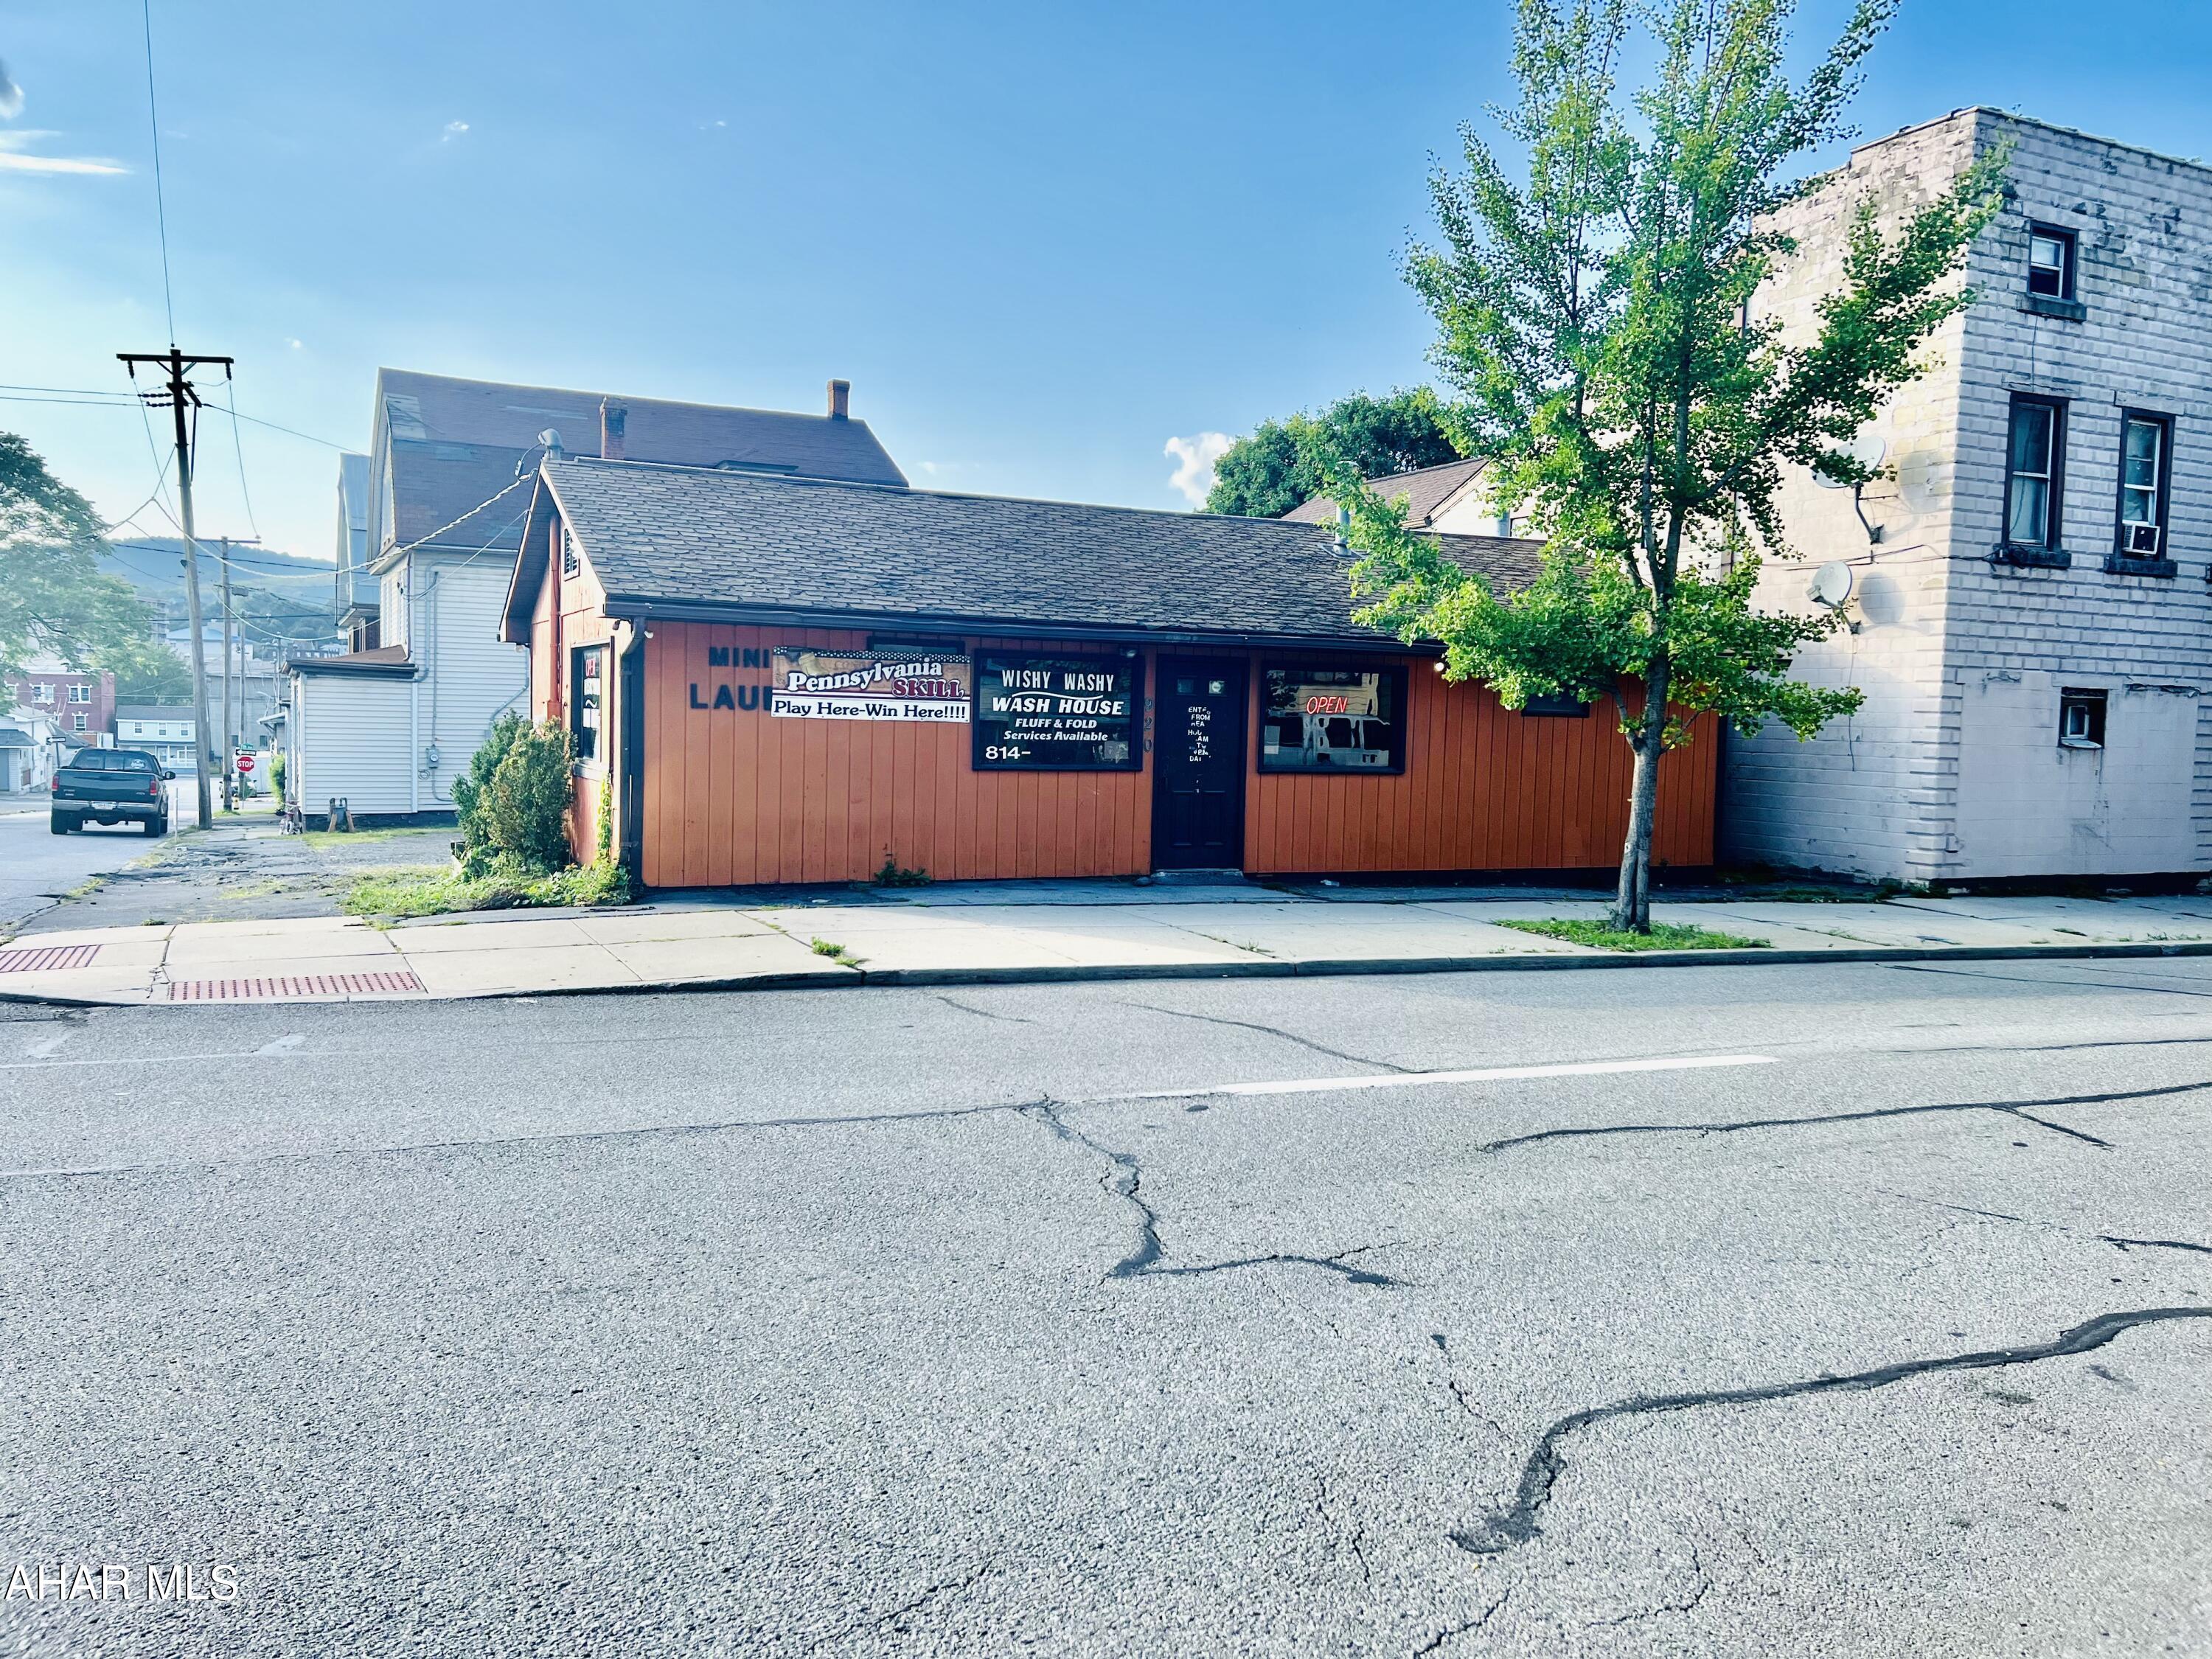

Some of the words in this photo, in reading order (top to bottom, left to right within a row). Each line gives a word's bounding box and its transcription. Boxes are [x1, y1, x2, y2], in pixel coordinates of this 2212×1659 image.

[709, 647, 770, 668] MINI
[787, 657, 942, 692] Pennsylvania
[1002, 669, 1051, 689] WISHY
[1064, 672, 1114, 692] WASHY
[892, 677, 964, 698] SKILL
[774, 700, 811, 716] Play
[817, 701, 897, 717] Here-Win
[904, 704, 966, 719] Here!!!!
[992, 697, 1050, 713] WASH
[1058, 699, 1124, 715] HOUSE
[1307, 696, 1348, 714] OPEN
[1015, 718, 1051, 728] FLUFF
[1054, 718, 1062, 728] &
[1065, 719, 1098, 728] FOLD
[1004, 730, 1051, 740] Services
[1054, 731, 1108, 741] Available
[985, 746, 1031, 759] 814-
